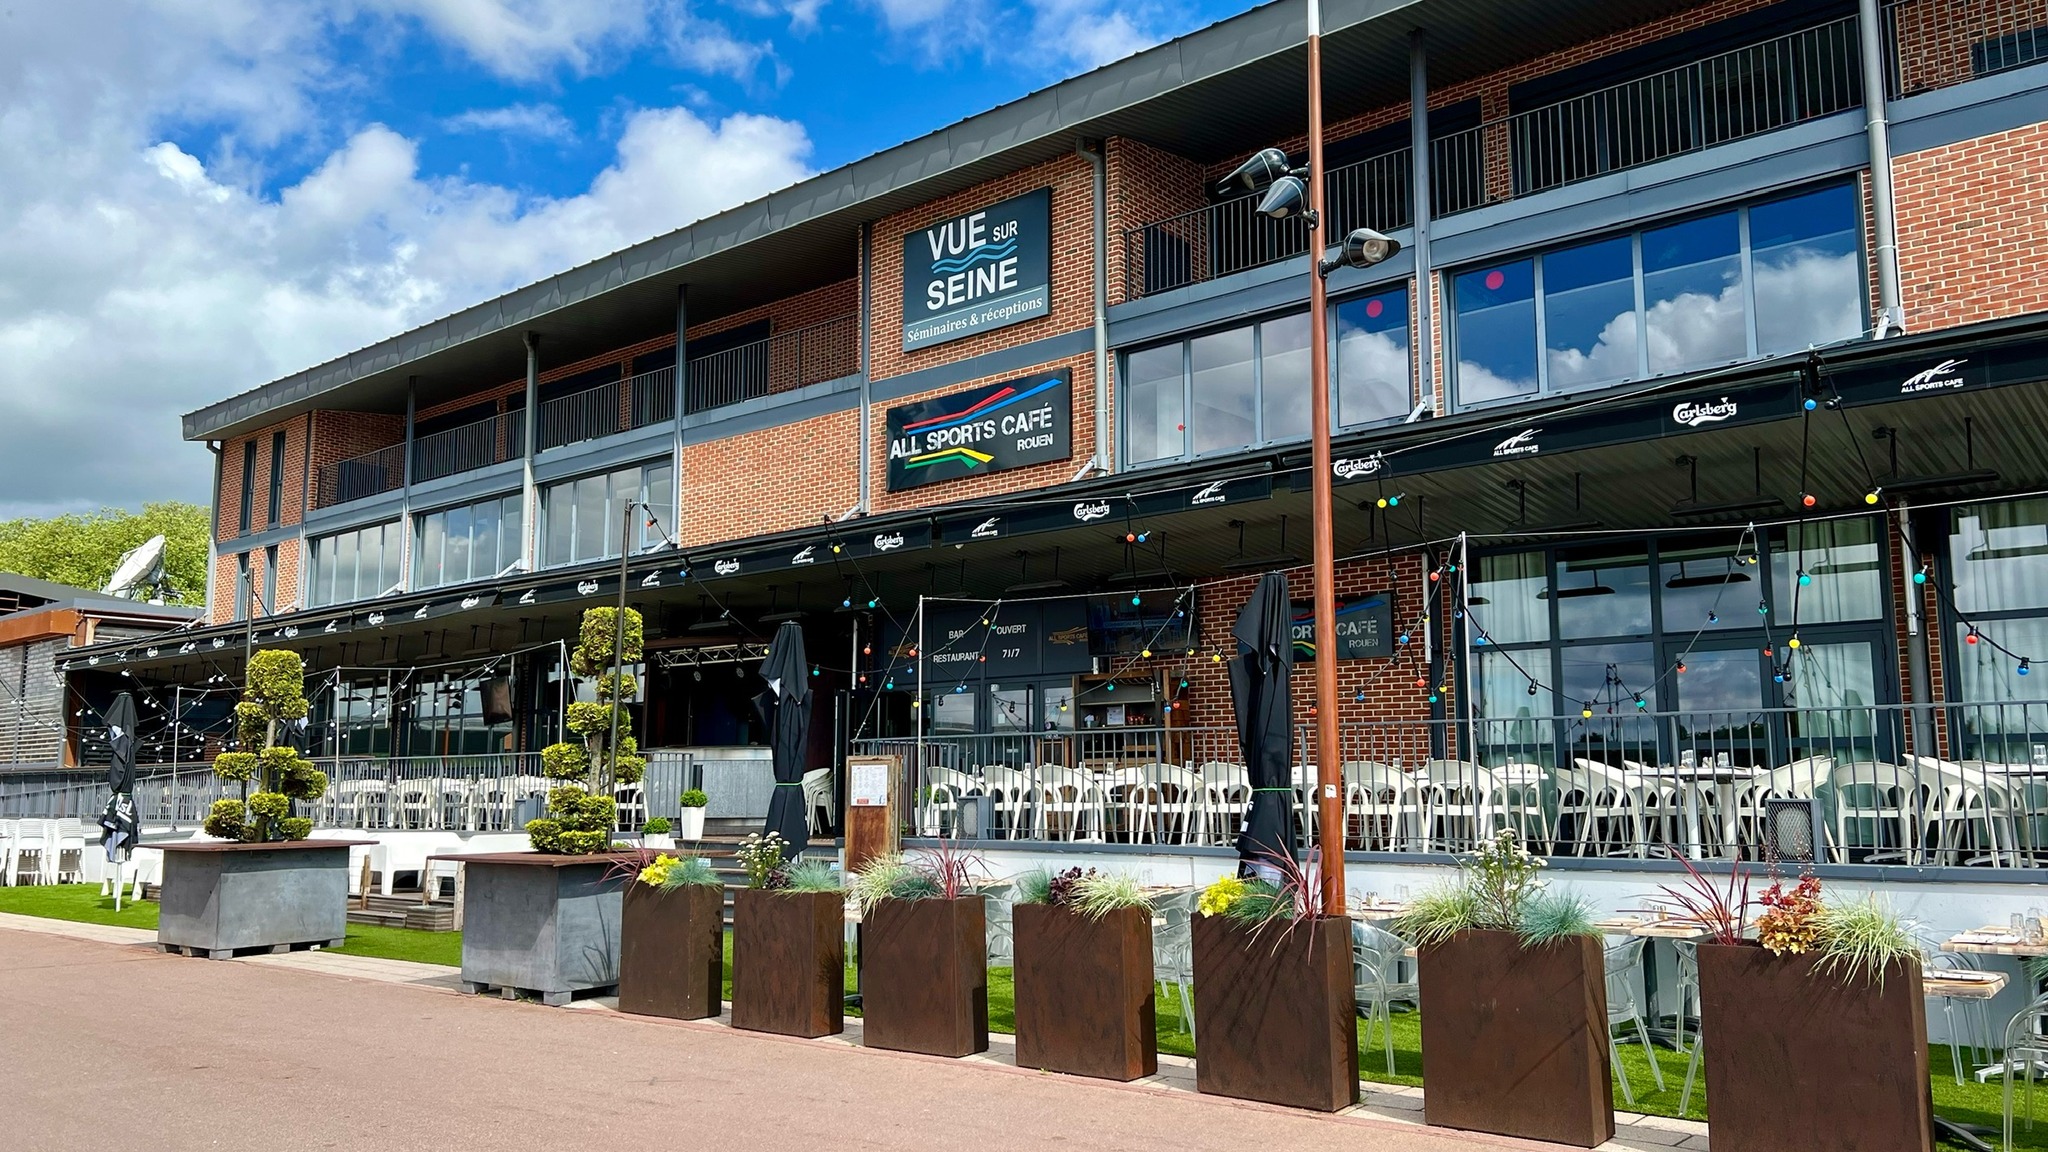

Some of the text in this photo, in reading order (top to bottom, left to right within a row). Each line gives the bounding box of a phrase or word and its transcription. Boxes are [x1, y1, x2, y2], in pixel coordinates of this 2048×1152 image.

[927, 212, 1018, 260] VUE SUR
[926, 256, 1018, 311] SEINE
[907, 297, 1043, 343] Séminaires & réceptions
[1901, 385, 1915, 393] ALL
[1916, 381, 1943, 391] SPORTS
[1673, 397, 1737, 426] Carlsberg
[890, 402, 1052, 460] ALL SPORTS CAFÉ
[1017, 433, 1053, 451] ROUEN
[1333, 455, 1381, 478] Carlsberg
[1073, 500, 1110, 521] Carlsberg
[948, 630, 965, 640] BAR
[996, 624, 1027, 635] OUVERT
[1336, 616, 1378, 636] CAFÉ
[1348, 638, 1379, 648] ROUEN
[933, 651, 980, 663] RESTAURANT
